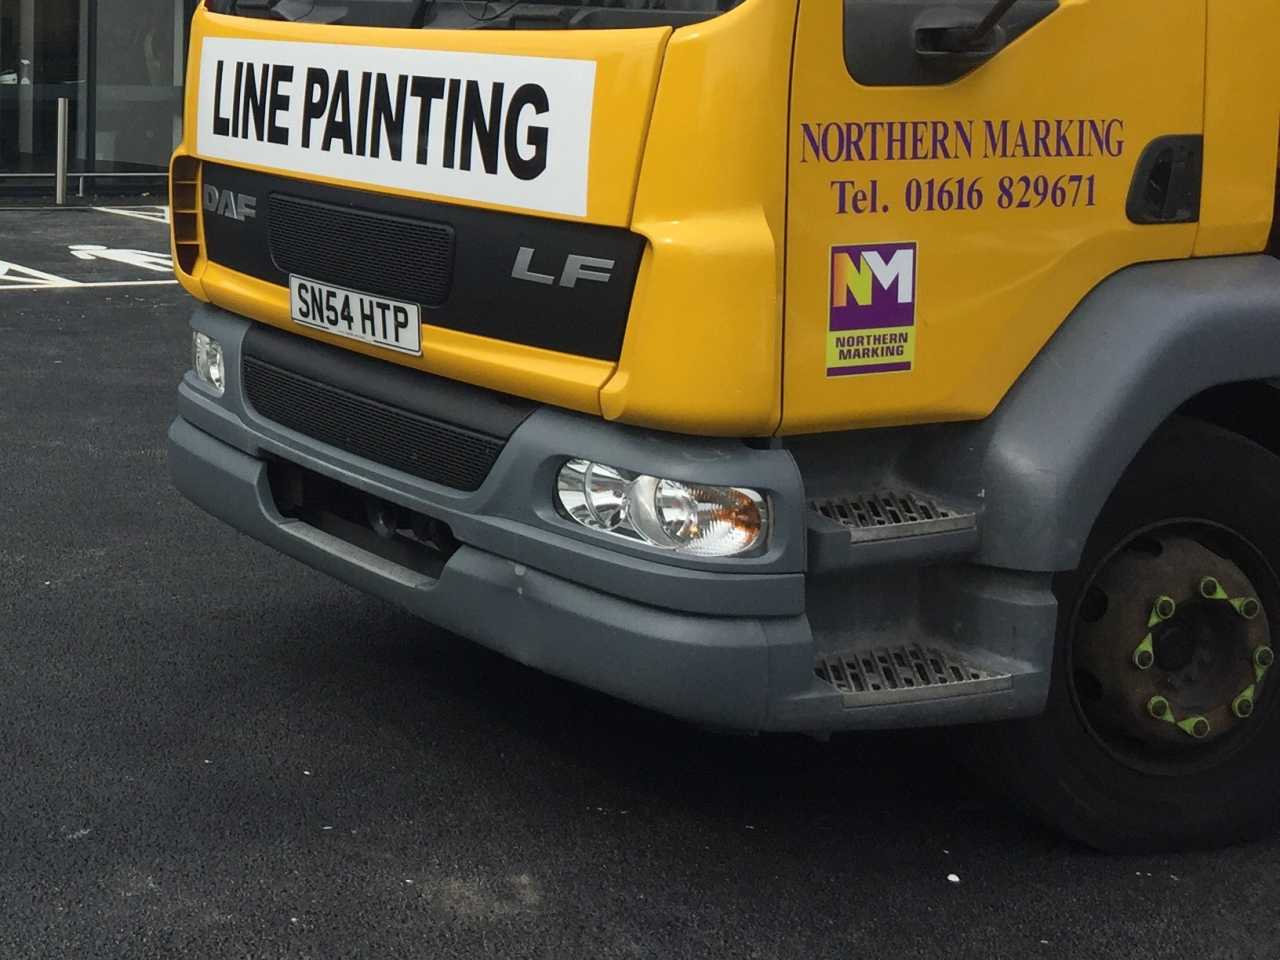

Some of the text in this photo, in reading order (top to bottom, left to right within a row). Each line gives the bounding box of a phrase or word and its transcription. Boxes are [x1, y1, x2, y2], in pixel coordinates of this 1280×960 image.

[212, 60, 550, 181] LINE PAINTING
[800, 118, 1125, 162] NORTHERN MARKING
[203, 183, 257, 222] DAF
[830, 173, 1097, 214] Tel. 01616 829671
[510, 246, 616, 288] LF
[831, 248, 914, 307] NM
[297, 281, 409, 343] SN54 HTP
[835, 332, 909, 348] NORTHERN
[838, 345, 904, 360] MARKING
